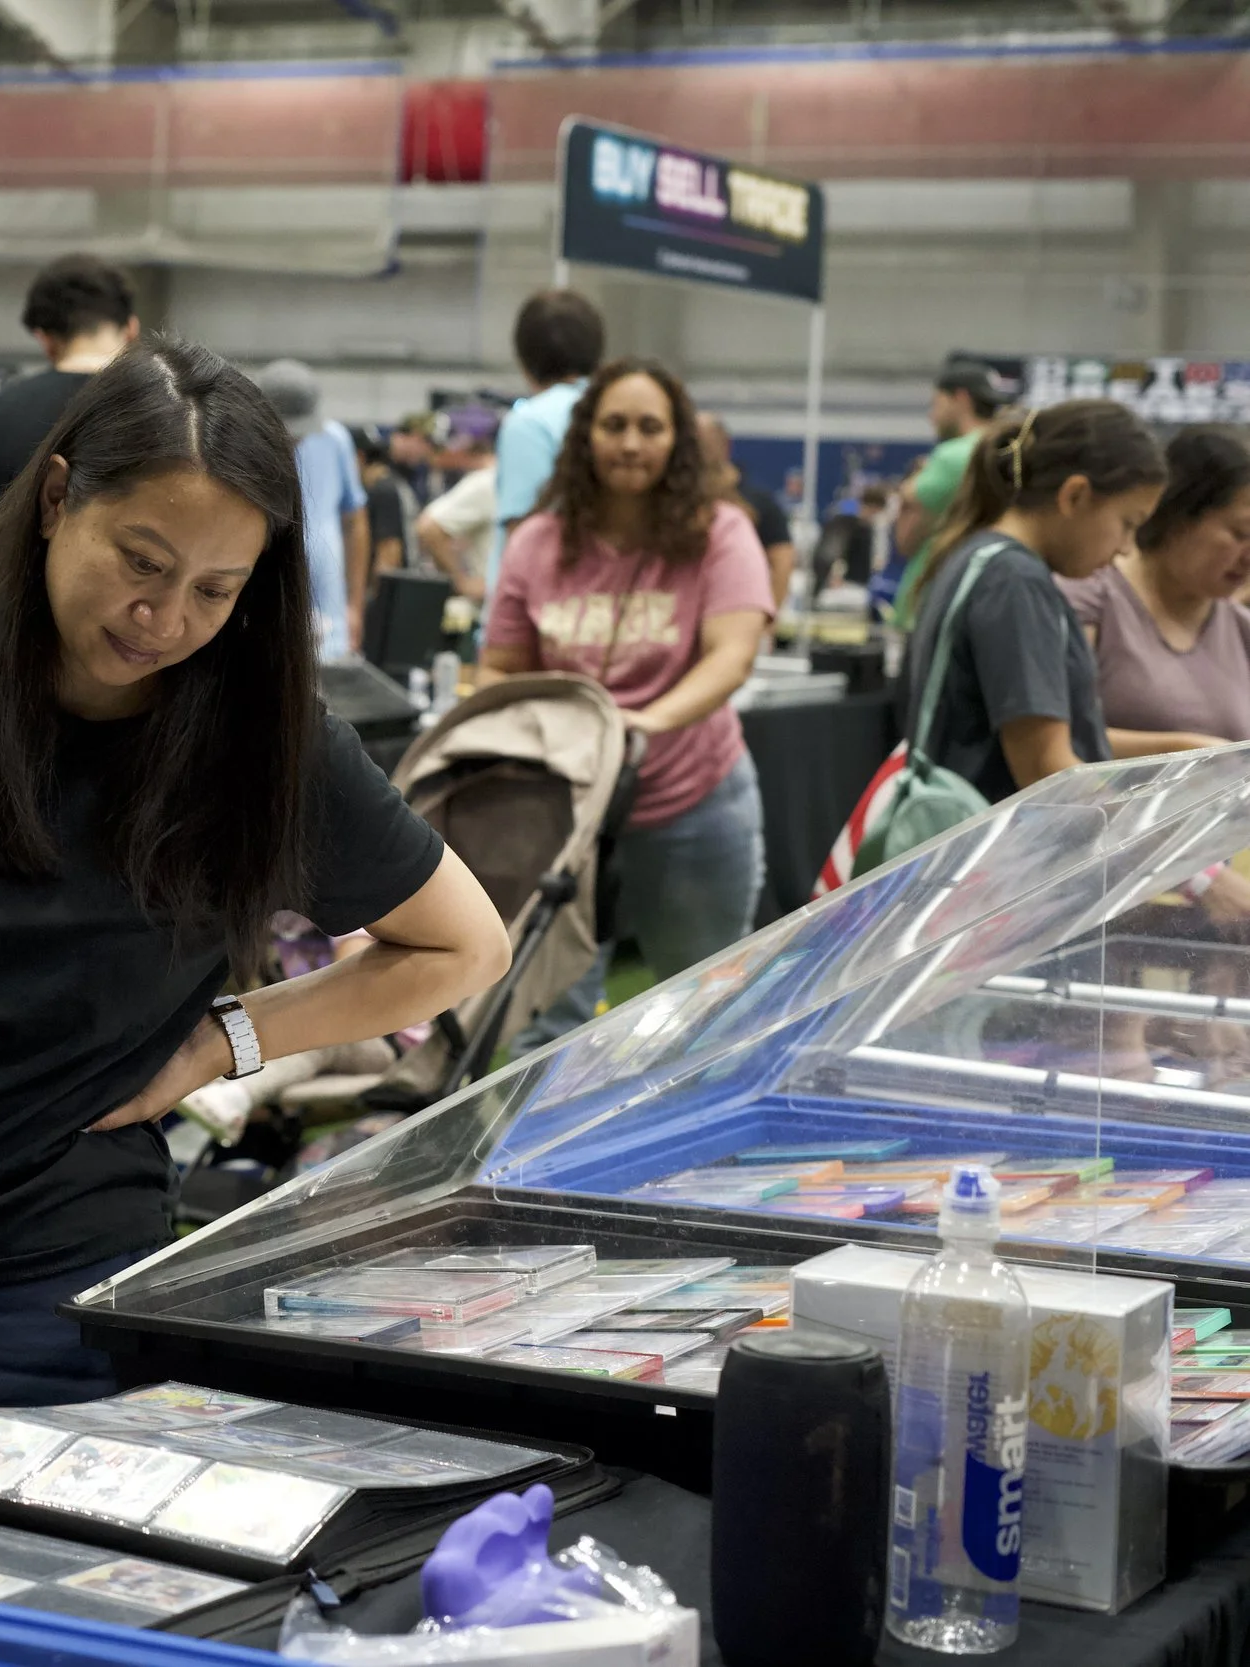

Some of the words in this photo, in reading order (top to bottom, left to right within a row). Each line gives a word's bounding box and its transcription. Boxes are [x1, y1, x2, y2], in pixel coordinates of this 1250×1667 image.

[593, 135, 654, 200] BUY
[655, 152, 727, 219] SELL
[995, 1391, 1027, 1557] smart
